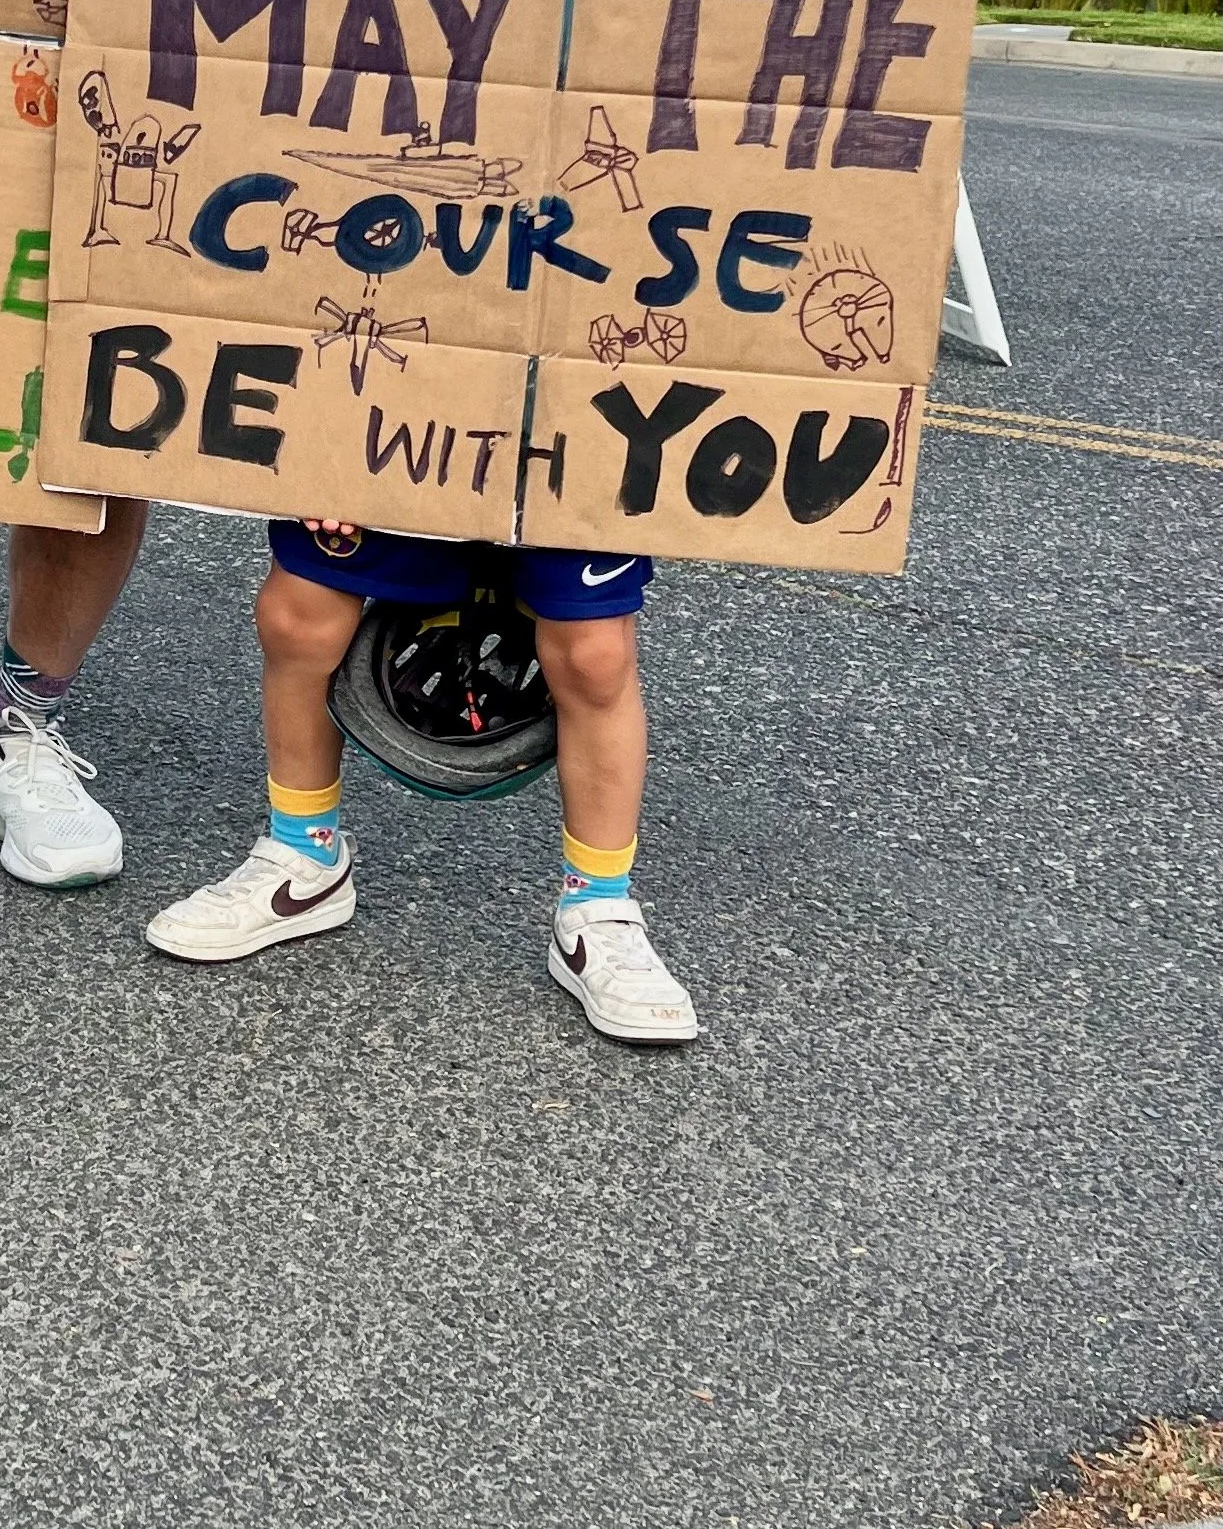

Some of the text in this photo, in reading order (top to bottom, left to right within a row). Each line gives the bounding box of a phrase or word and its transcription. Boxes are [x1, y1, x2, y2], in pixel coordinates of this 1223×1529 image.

[189, 172, 811, 312] COURSE
[81, 324, 302, 475] BE
[365, 406, 564, 502] WITH
